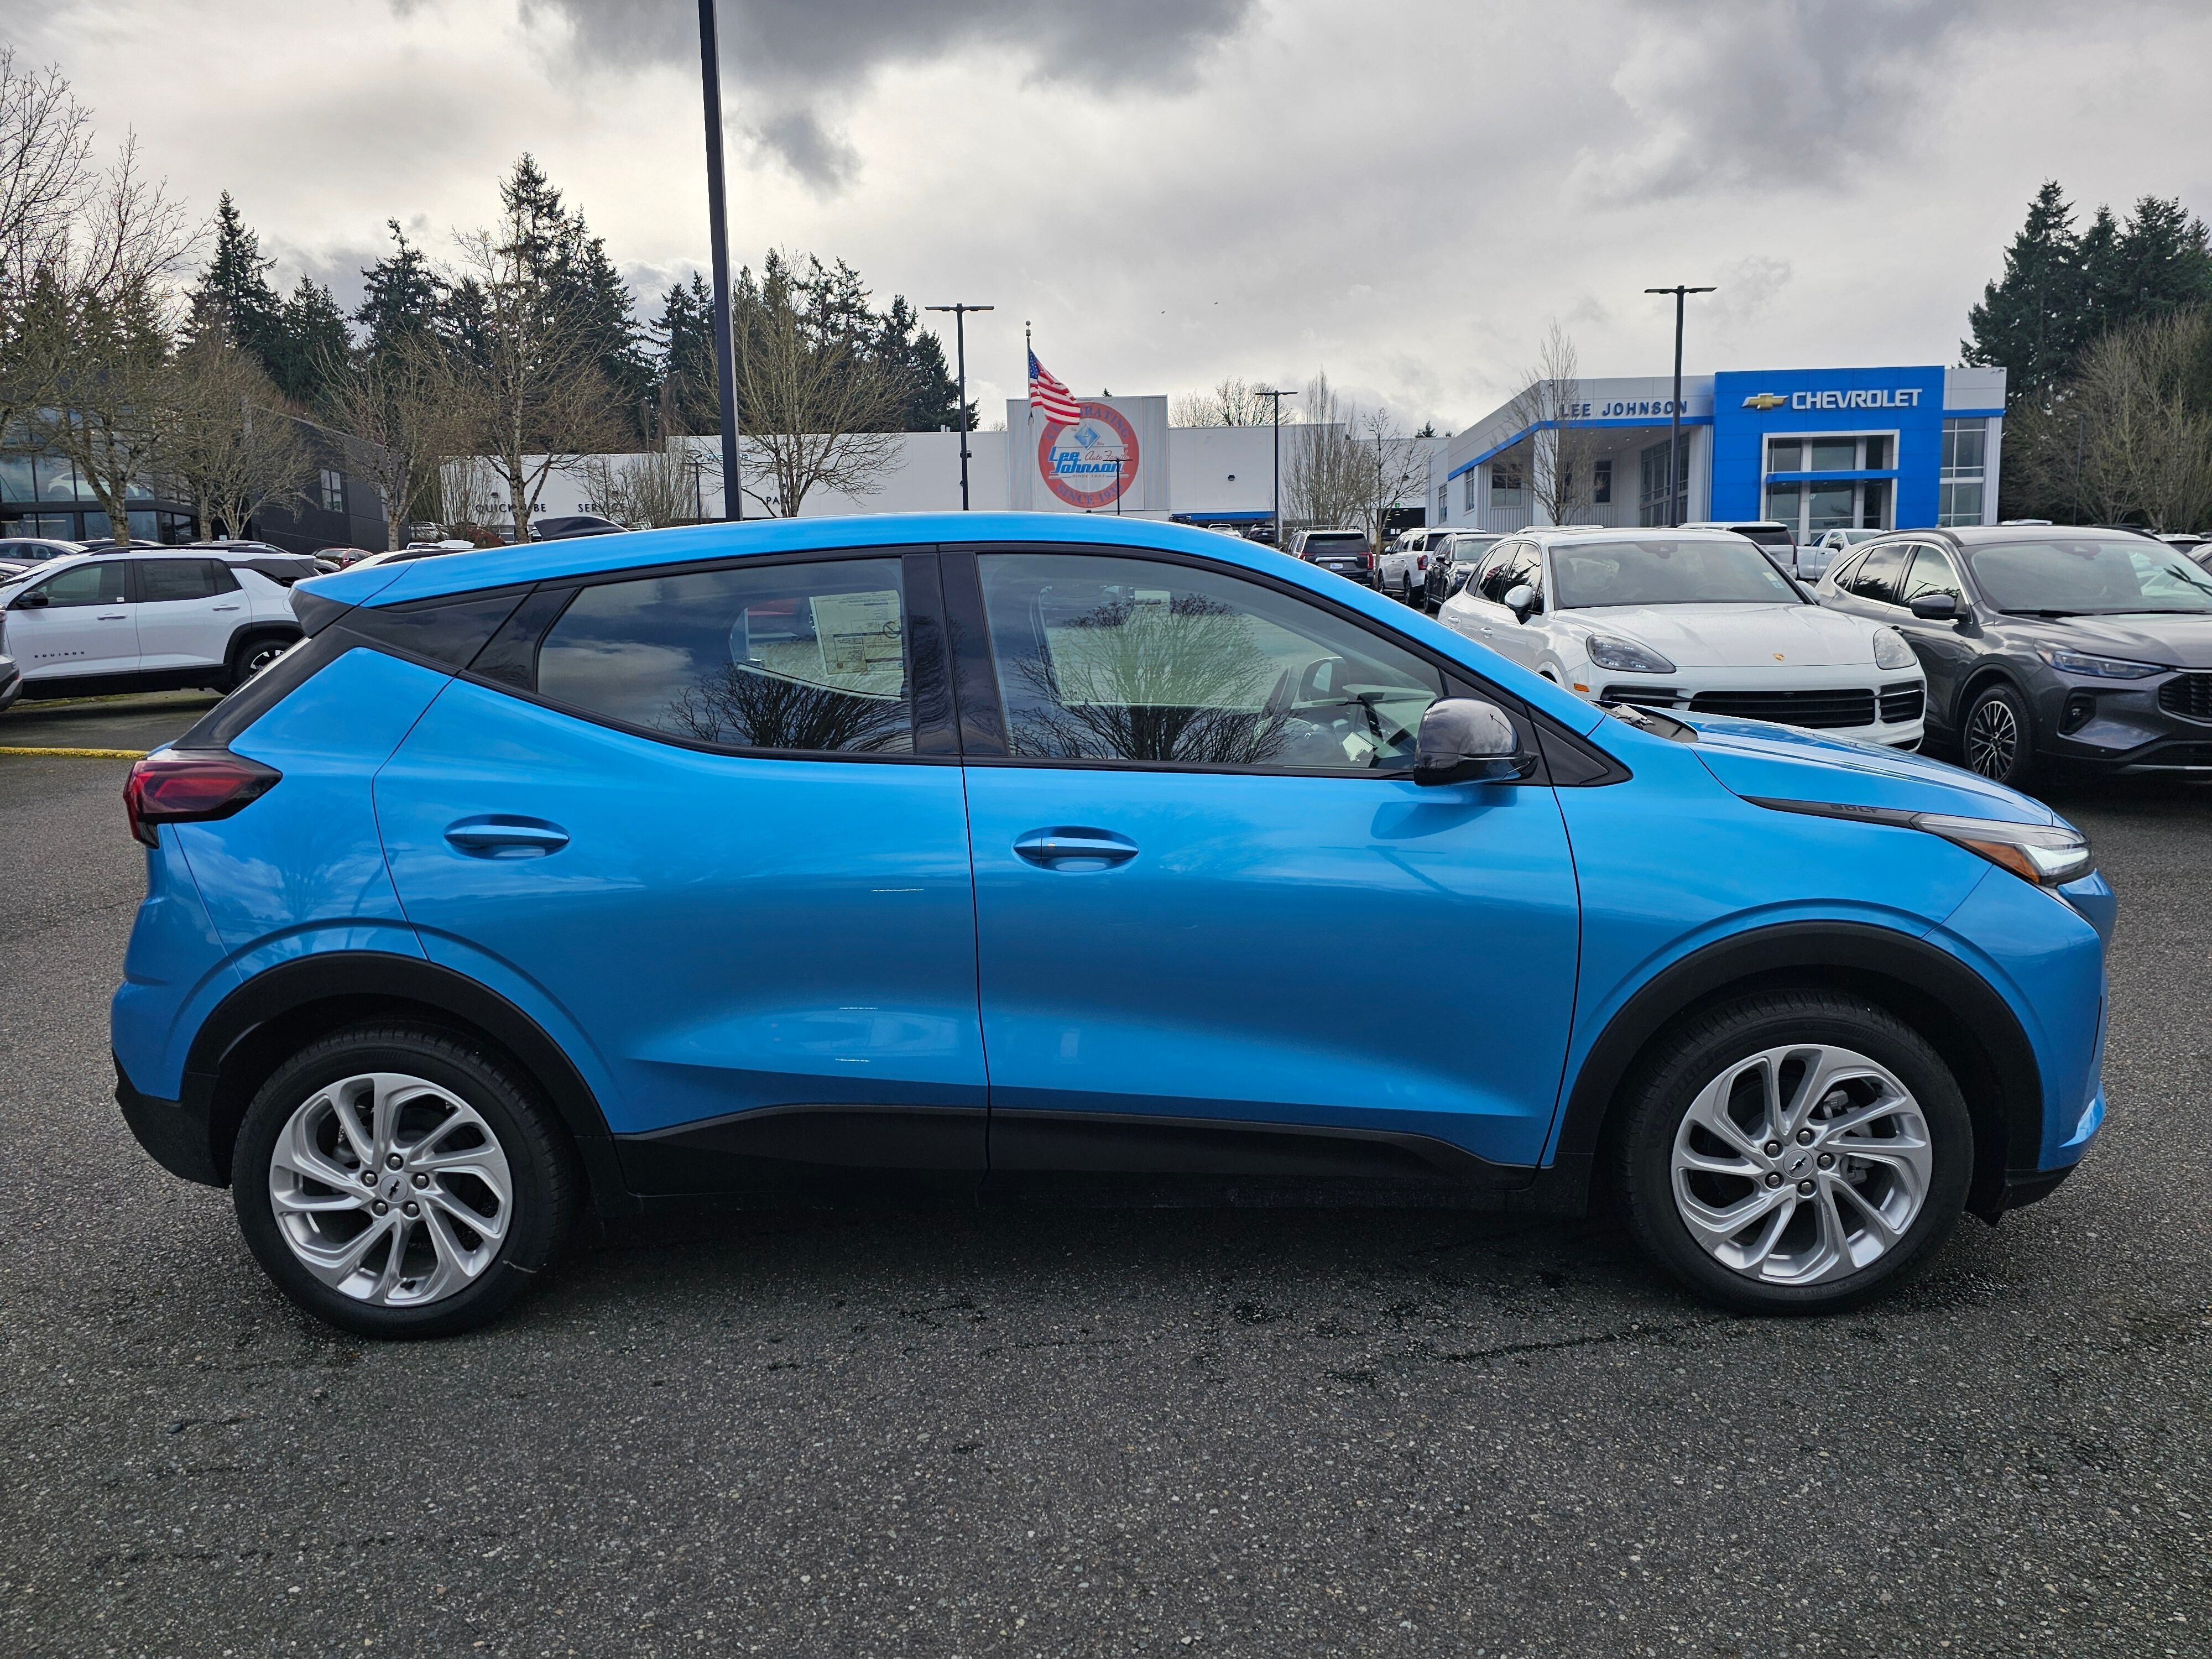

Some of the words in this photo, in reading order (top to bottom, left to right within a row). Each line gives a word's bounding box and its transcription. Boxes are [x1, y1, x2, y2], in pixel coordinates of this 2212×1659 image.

[1792, 389, 1922, 409] CHEVROLET
[1561, 403, 1591, 416] LEE
[1601, 400, 1687, 416] JOHNSON
[1048, 446, 1081, 461] Lee
[1085, 451, 1102, 461] Auto
[1104, 450, 1130, 460] Family
[1050, 452, 1124, 473] Johnson
[1057, 483, 1095, 504] SINCE
[1829, 804, 1878, 813] BOLT
